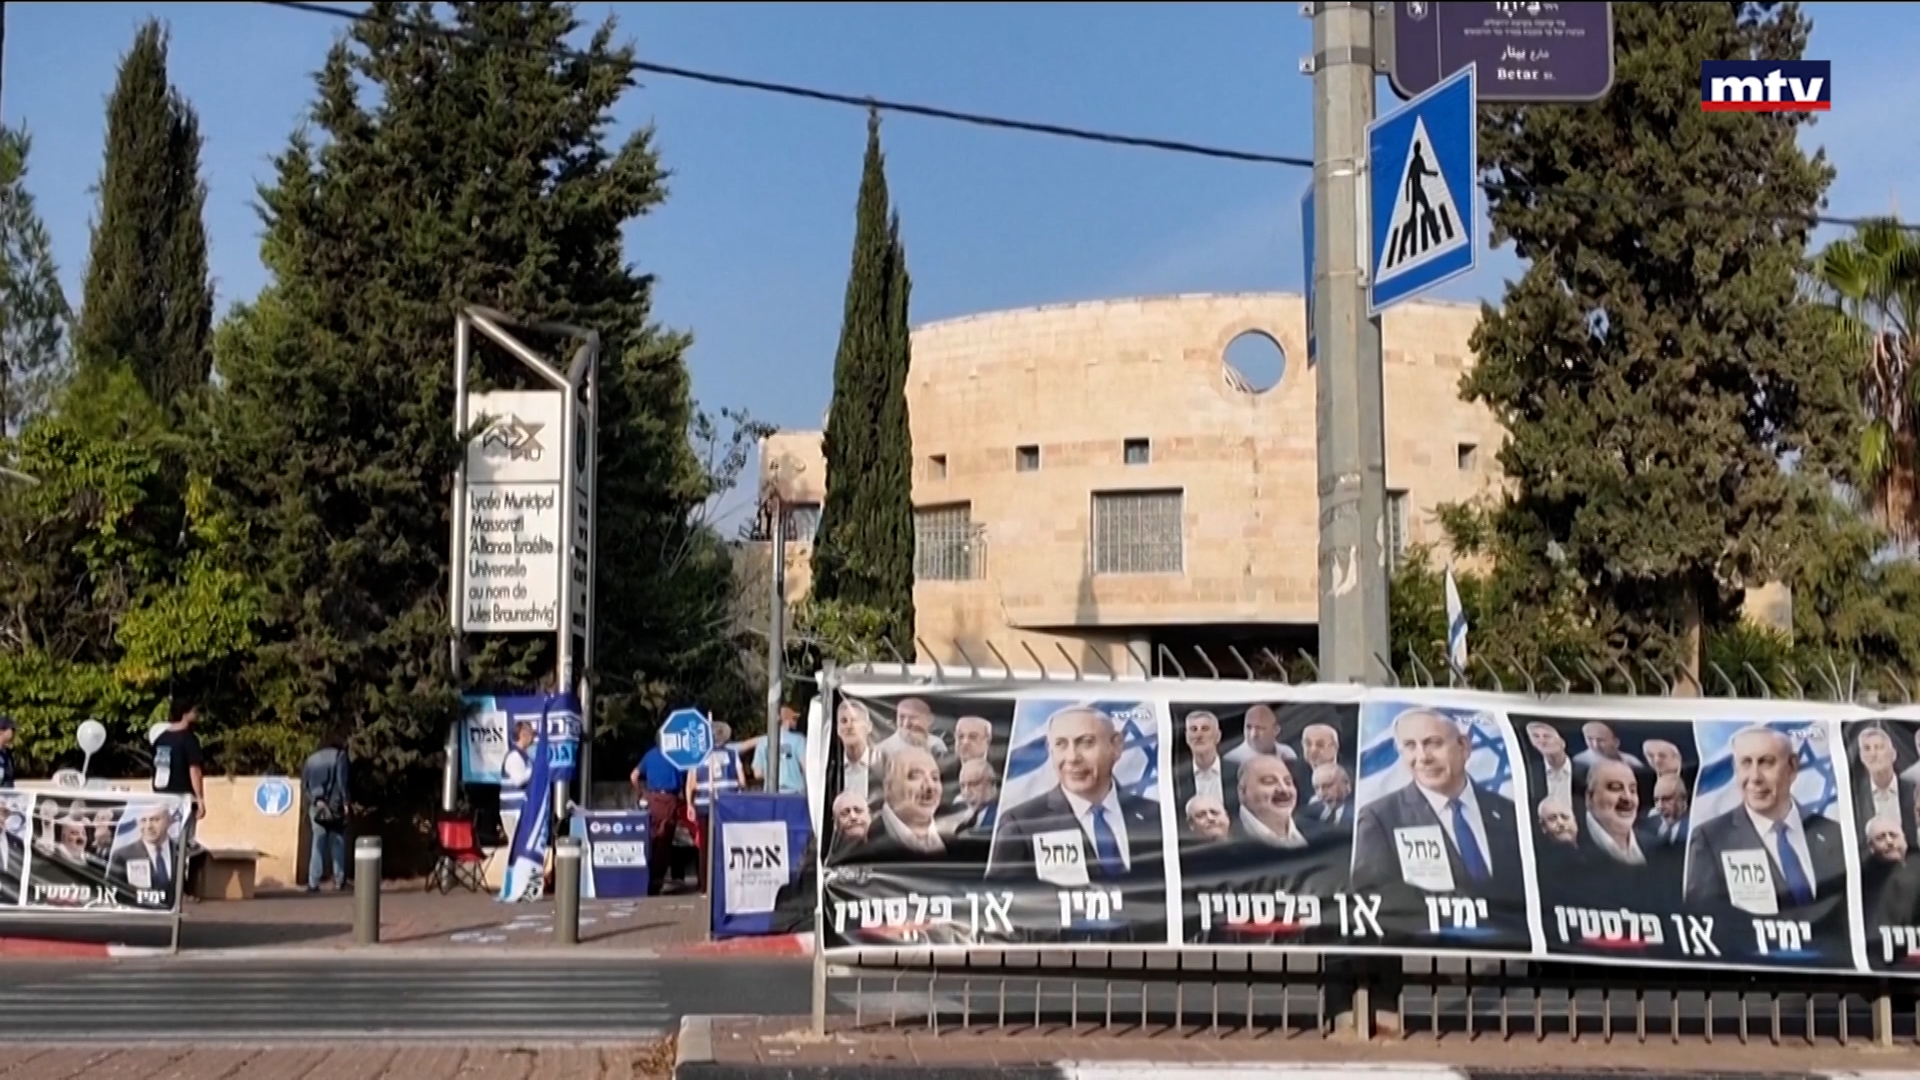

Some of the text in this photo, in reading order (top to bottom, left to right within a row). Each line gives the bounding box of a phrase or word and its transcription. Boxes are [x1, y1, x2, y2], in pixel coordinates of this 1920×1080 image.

[1497, 67, 1538, 80] Betar
[504, 488, 555, 516] Municipal
[470, 515, 524, 532] Massorati
[469, 557, 527, 577] Universelle
[469, 580, 527, 599] au nom de
[470, 726, 504, 744] אמת
[729, 845, 781, 870] אמת
[1038, 838, 1080, 865] מחל
[1400, 832, 1441, 860] מחל
[1730, 856, 1766, 884] מחל
[34, 882, 166, 904] ימין או פלסטין
[833, 890, 1124, 934] ימין או פלסטין
[1198, 891, 1489, 938] ימין או פלסטין
[1554, 906, 1813, 956] ימין או פלסטין
